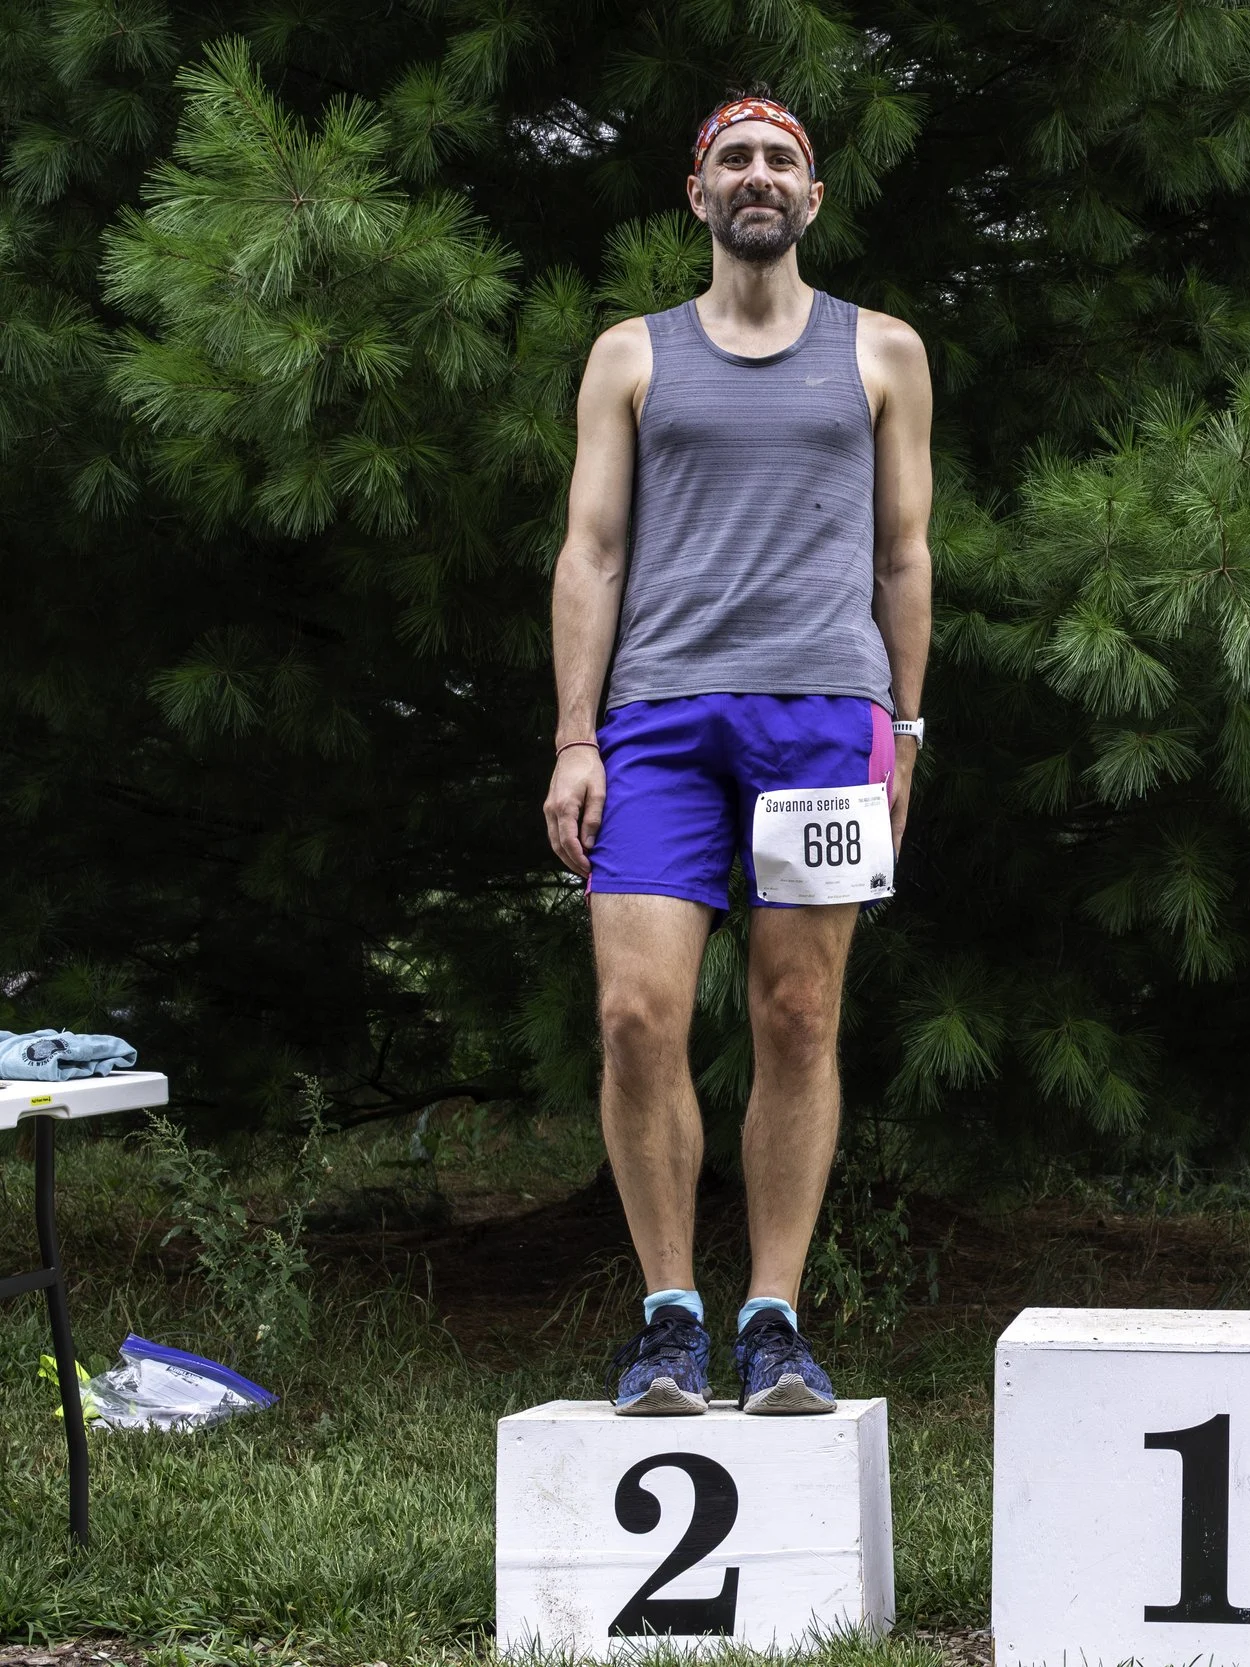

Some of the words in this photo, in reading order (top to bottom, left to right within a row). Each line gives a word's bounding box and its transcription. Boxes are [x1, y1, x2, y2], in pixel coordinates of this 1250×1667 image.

[766, 799, 813, 813] Savanna
[817, 797, 850, 811] series
[803, 820, 862, 868] 688
[607, 1451, 740, 1638] 2
